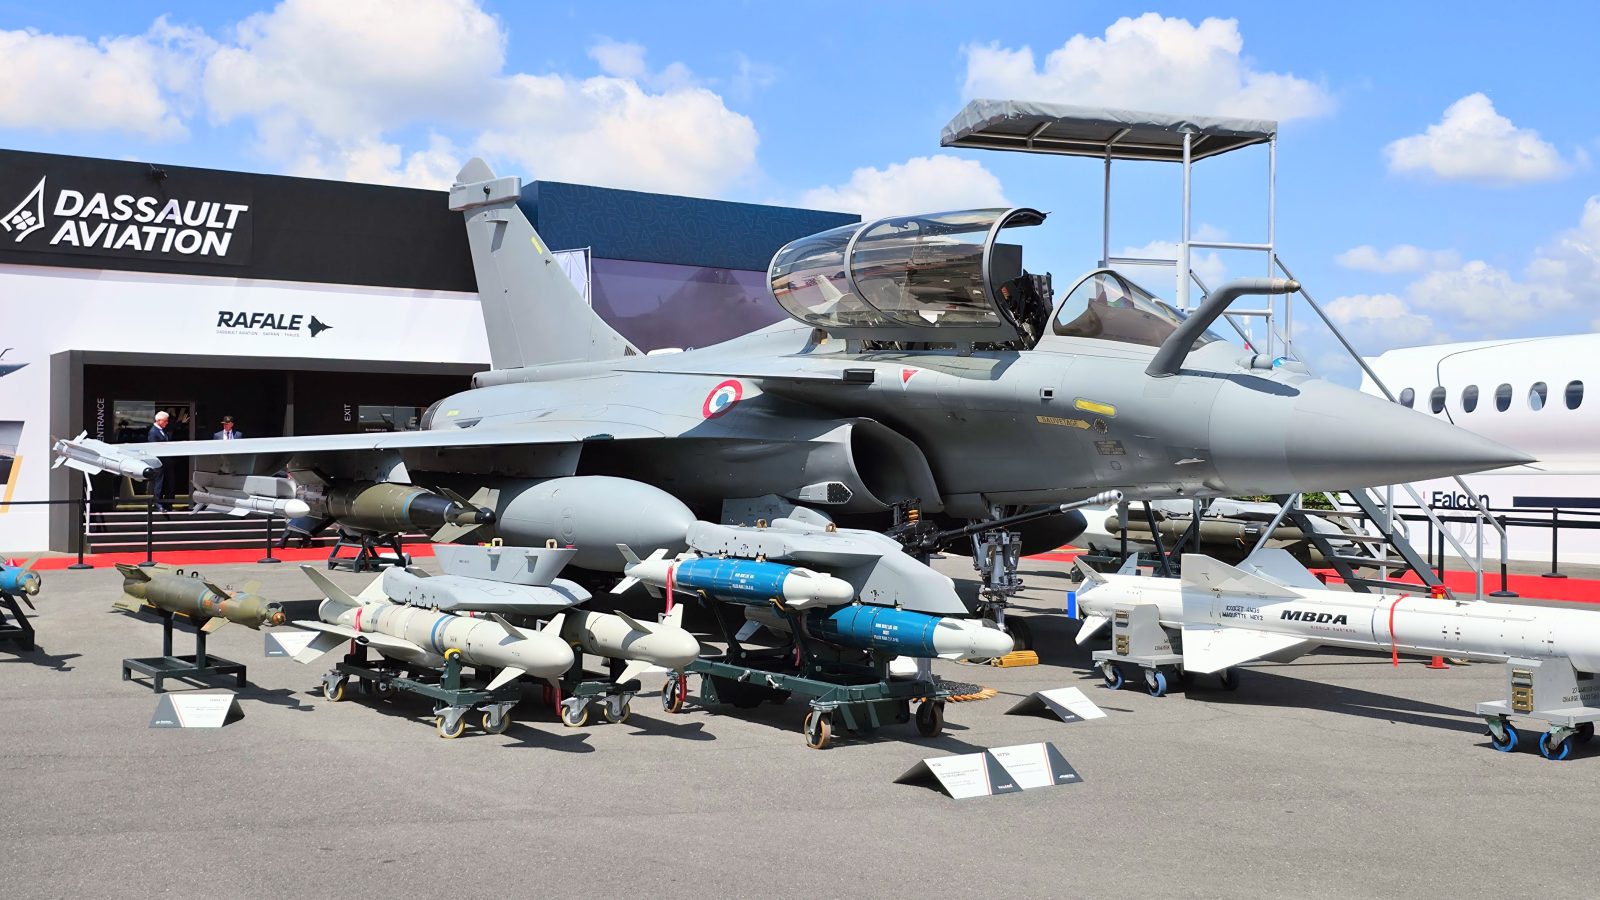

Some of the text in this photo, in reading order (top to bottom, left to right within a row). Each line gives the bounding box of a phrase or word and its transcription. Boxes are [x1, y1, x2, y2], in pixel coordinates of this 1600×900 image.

[53, 189, 249, 230] DASSAULT
[49, 220, 233, 257] AVIATION
[216, 310, 304, 331] RAFALE
[96, 397, 105, 442] ENTRANCE
[343, 403, 352, 422] EXIT
[1432, 491, 1490, 509] Falcon
[1280, 609, 1348, 626] MBDA
